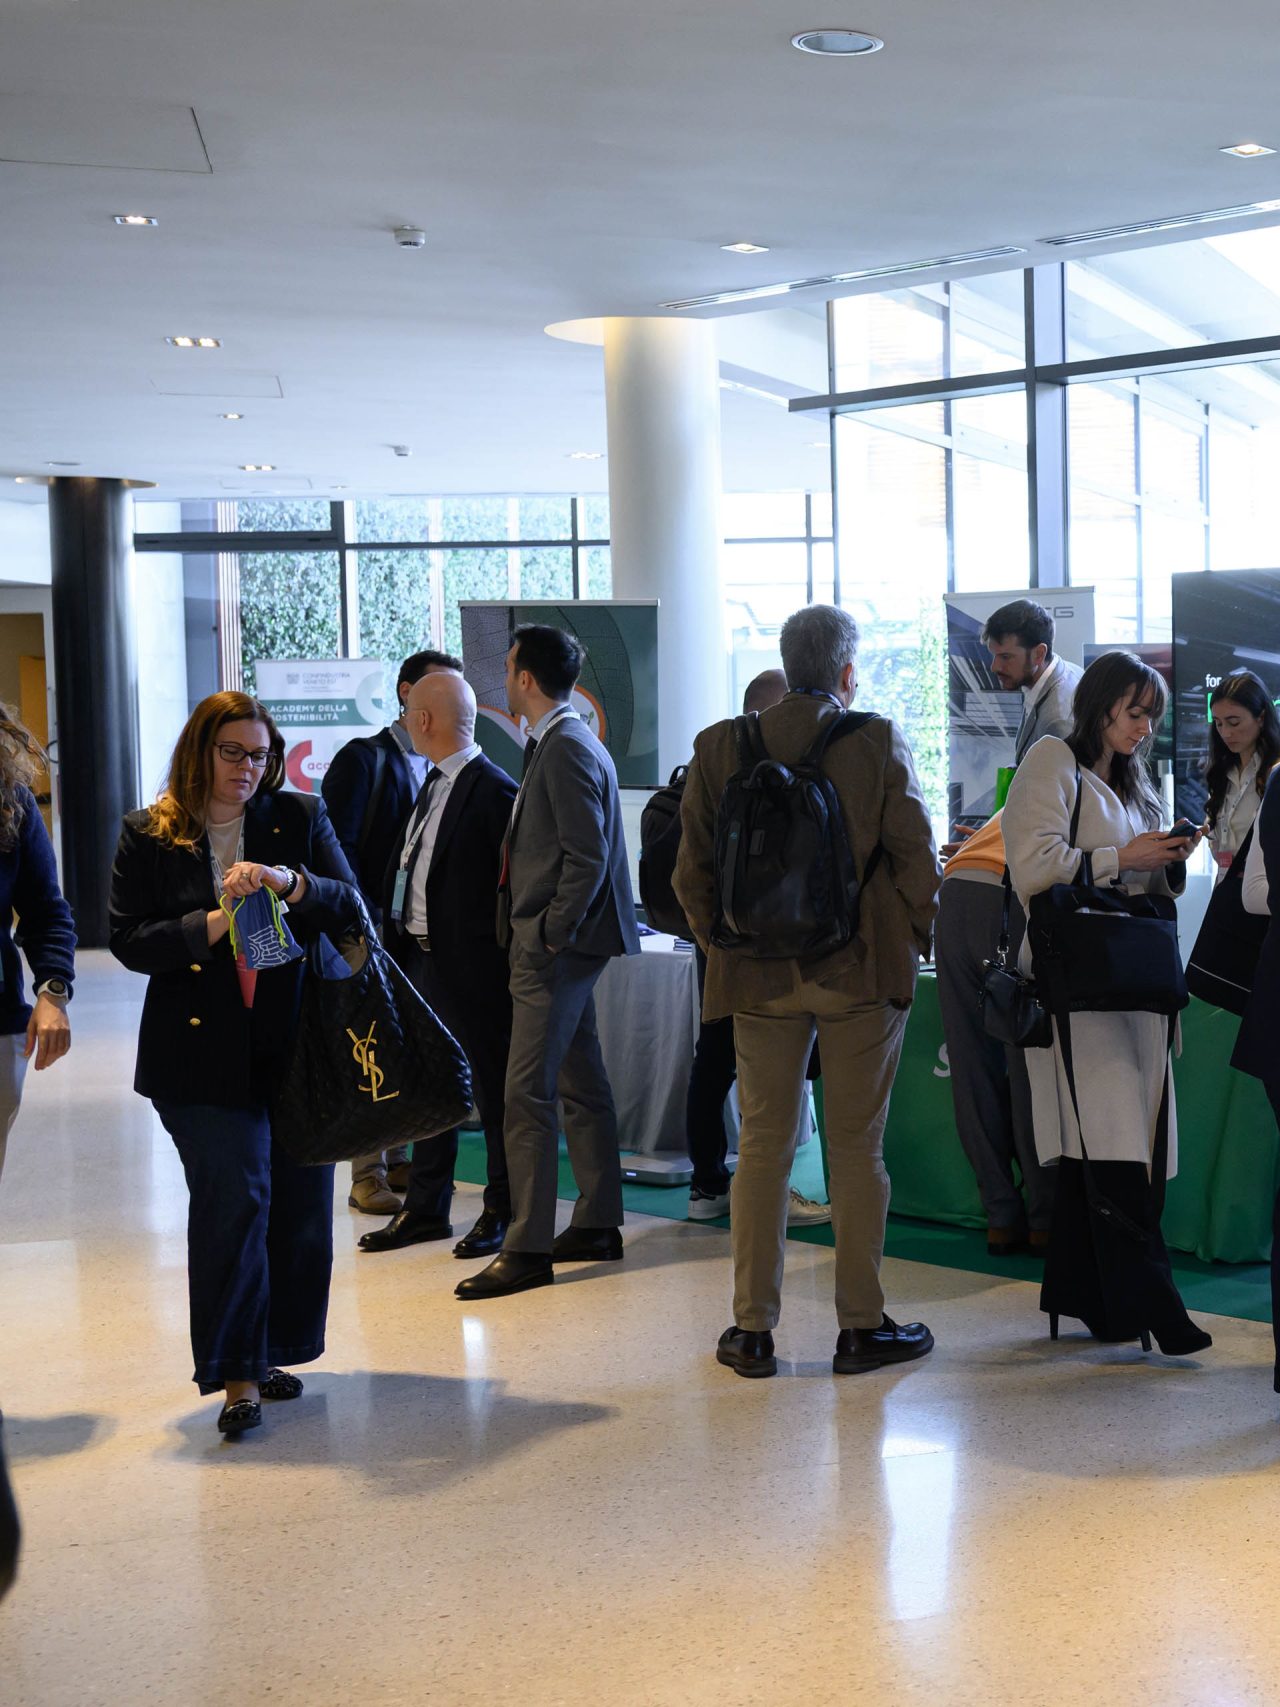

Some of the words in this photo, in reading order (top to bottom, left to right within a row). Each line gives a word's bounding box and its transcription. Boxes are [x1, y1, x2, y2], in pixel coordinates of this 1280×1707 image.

[1205, 673, 1222, 688] for
[270, 704, 314, 713] ACADEMY
[318, 704, 348, 712] DELLA
[346, 1020, 399, 1102] YSL
